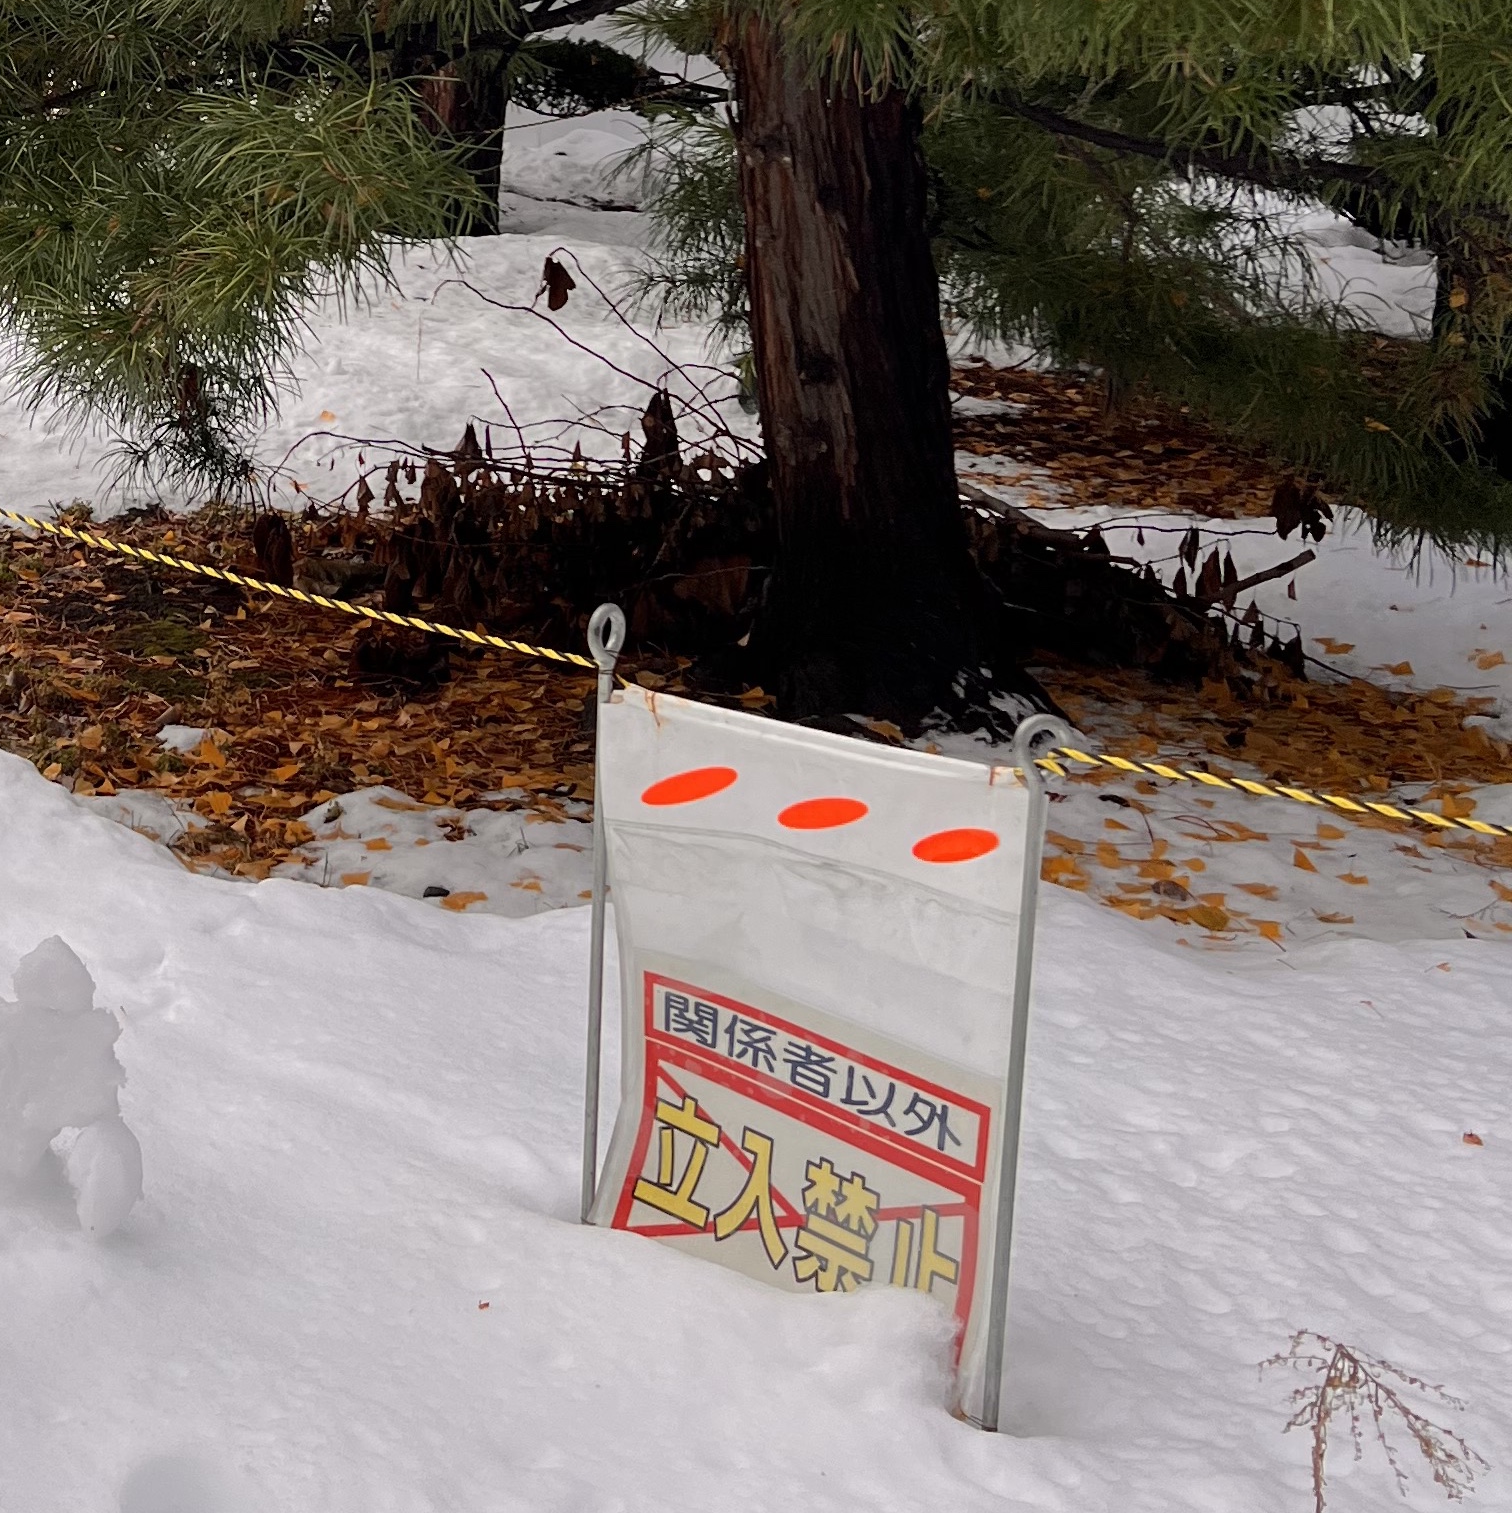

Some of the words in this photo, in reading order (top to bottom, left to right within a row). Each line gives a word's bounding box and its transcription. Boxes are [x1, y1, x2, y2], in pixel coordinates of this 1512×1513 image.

[664, 991, 961, 1151] 関係者以外
